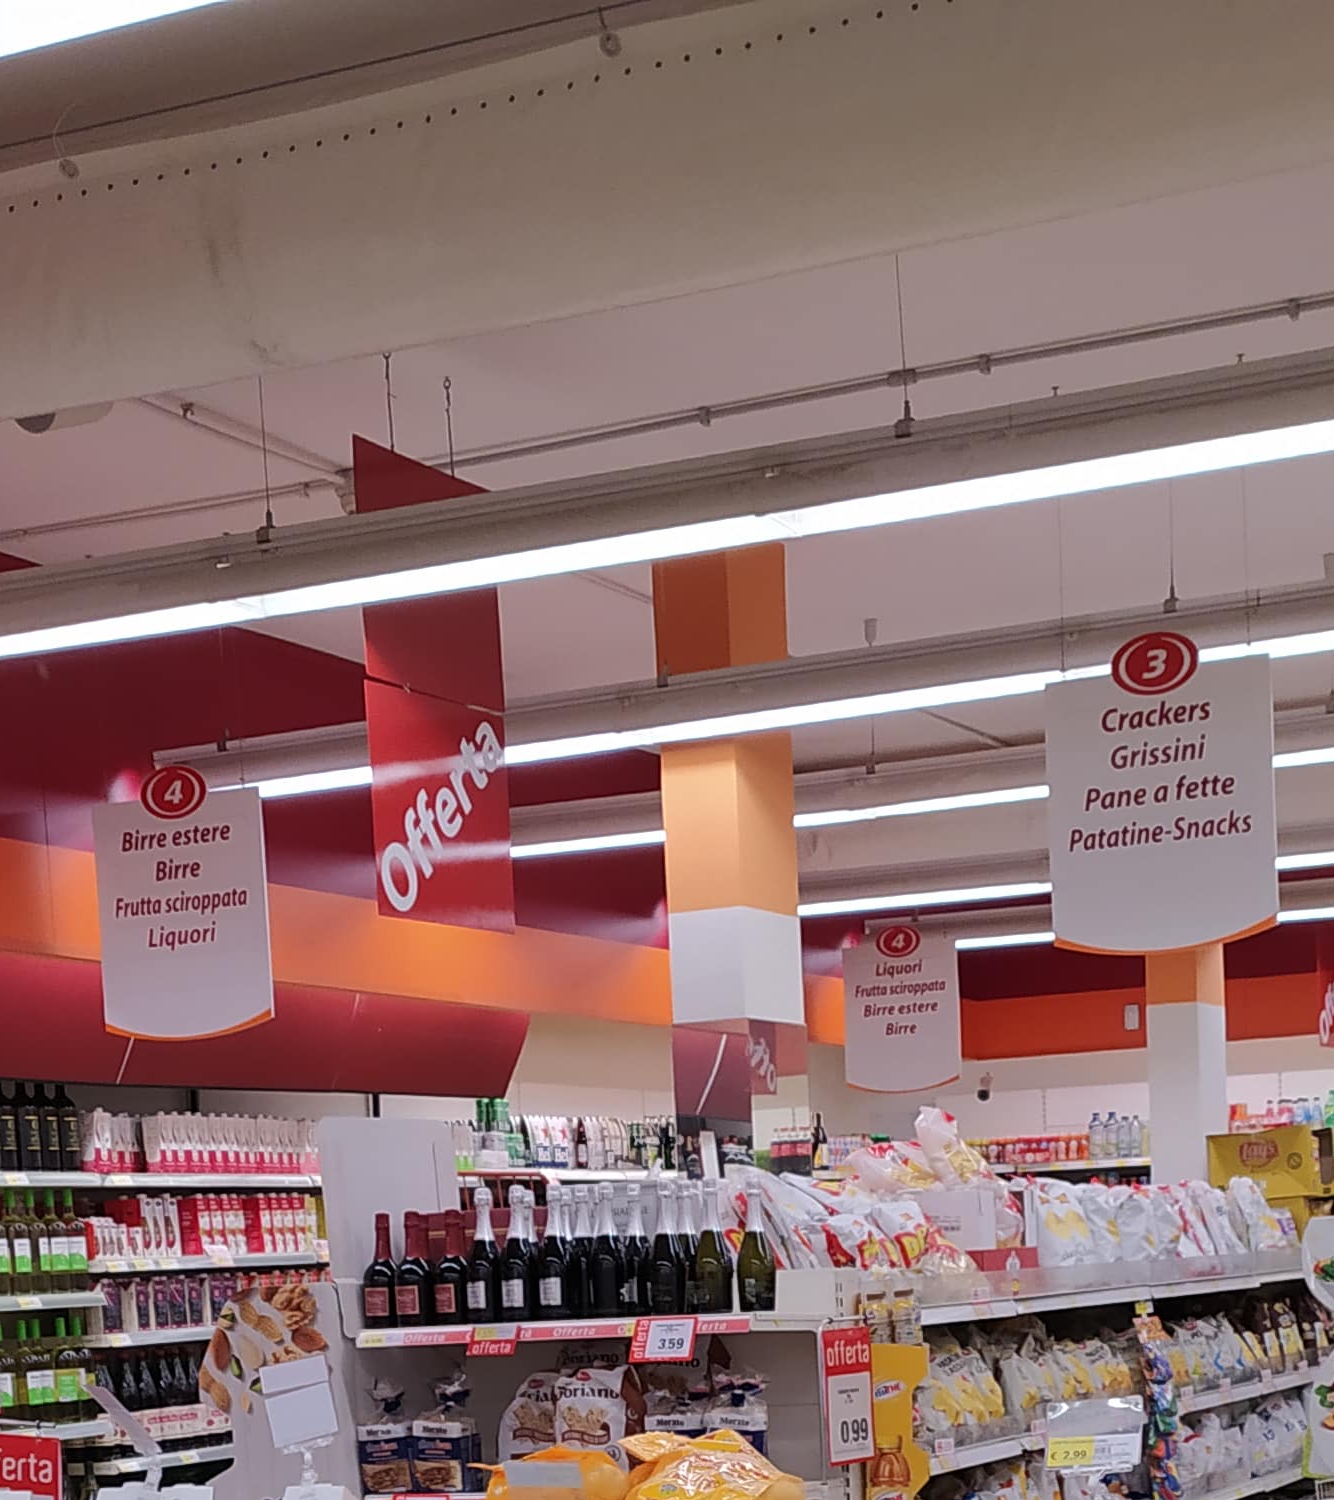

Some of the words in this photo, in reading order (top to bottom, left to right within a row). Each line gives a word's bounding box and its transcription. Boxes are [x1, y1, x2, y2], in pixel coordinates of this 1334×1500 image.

[1142, 649, 1167, 679] 3
[1101, 701, 1211, 733] Crackers
[1111, 734, 1205, 770] Grissini
[164, 780, 183, 804] 4
[1085, 788, 1147, 811] Pane
[1154, 785, 1168, 803] a
[1176, 775, 1235, 801] fette
[381, 721, 503, 912] Offerta
[122, 829, 167, 852] Birre
[172, 824, 230, 846] estere
[1070, 810, 1252, 853] Patatine-Snacks
[155, 859, 201, 882] Birre
[115, 898, 162, 918] Frutta
[165, 888, 248, 914] sciroppata
[148, 921, 216, 950] Liquori
[891, 933, 906, 949] 4
[875, 960, 923, 978] Liquori
[855, 985, 887, 998] Frutta
[889, 980, 946, 995] sciroppata
[864, 1003, 895, 1018] Birre
[898, 1002, 939, 1014] estere
[885, 1022, 917, 1036] Birre
[553, 1326, 596, 1337] Offerta
[472, 1342, 512, 1355] offerta
[827, 1343, 869, 1367] offerta
